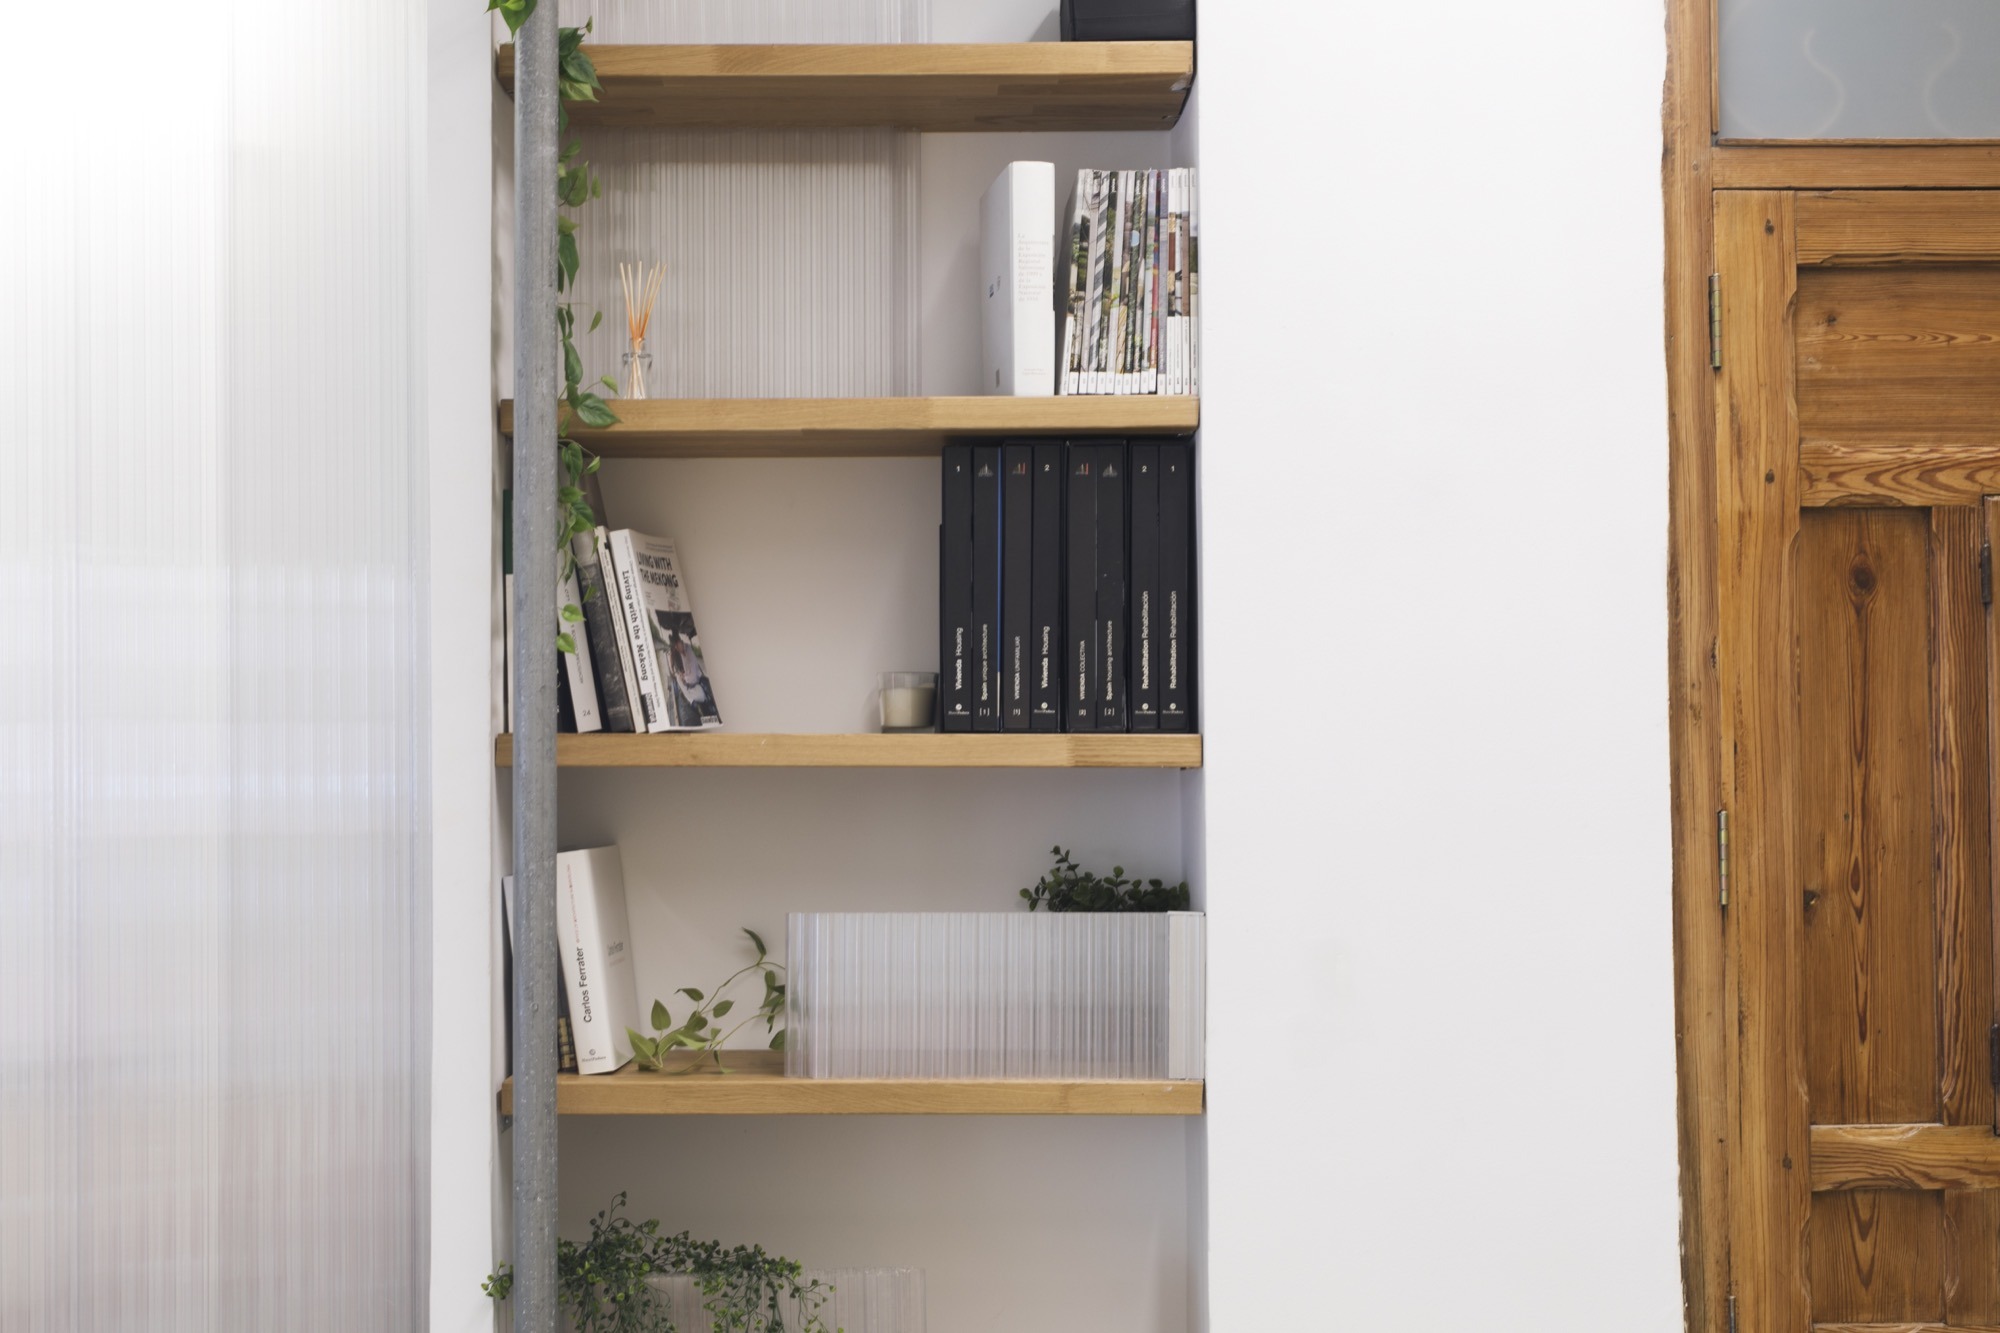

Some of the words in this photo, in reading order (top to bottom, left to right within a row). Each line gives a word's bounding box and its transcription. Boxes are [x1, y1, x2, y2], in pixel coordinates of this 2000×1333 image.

[636, 552, 654, 568] LIVING
[653, 555, 673, 571] WITH
[622, 570, 632, 600] Living
[640, 568, 652, 583] THE
[650, 570, 679, 588] MEKONG
[628, 602, 639, 624] with
[633, 625, 641, 640] the
[955, 627, 964, 656] Housing
[1042, 626, 1050, 655] Housing
[636, 644, 648, 681] Mekong
[576, 947, 588, 988] Ferrater
[582, 989, 592, 1023] Carlos
